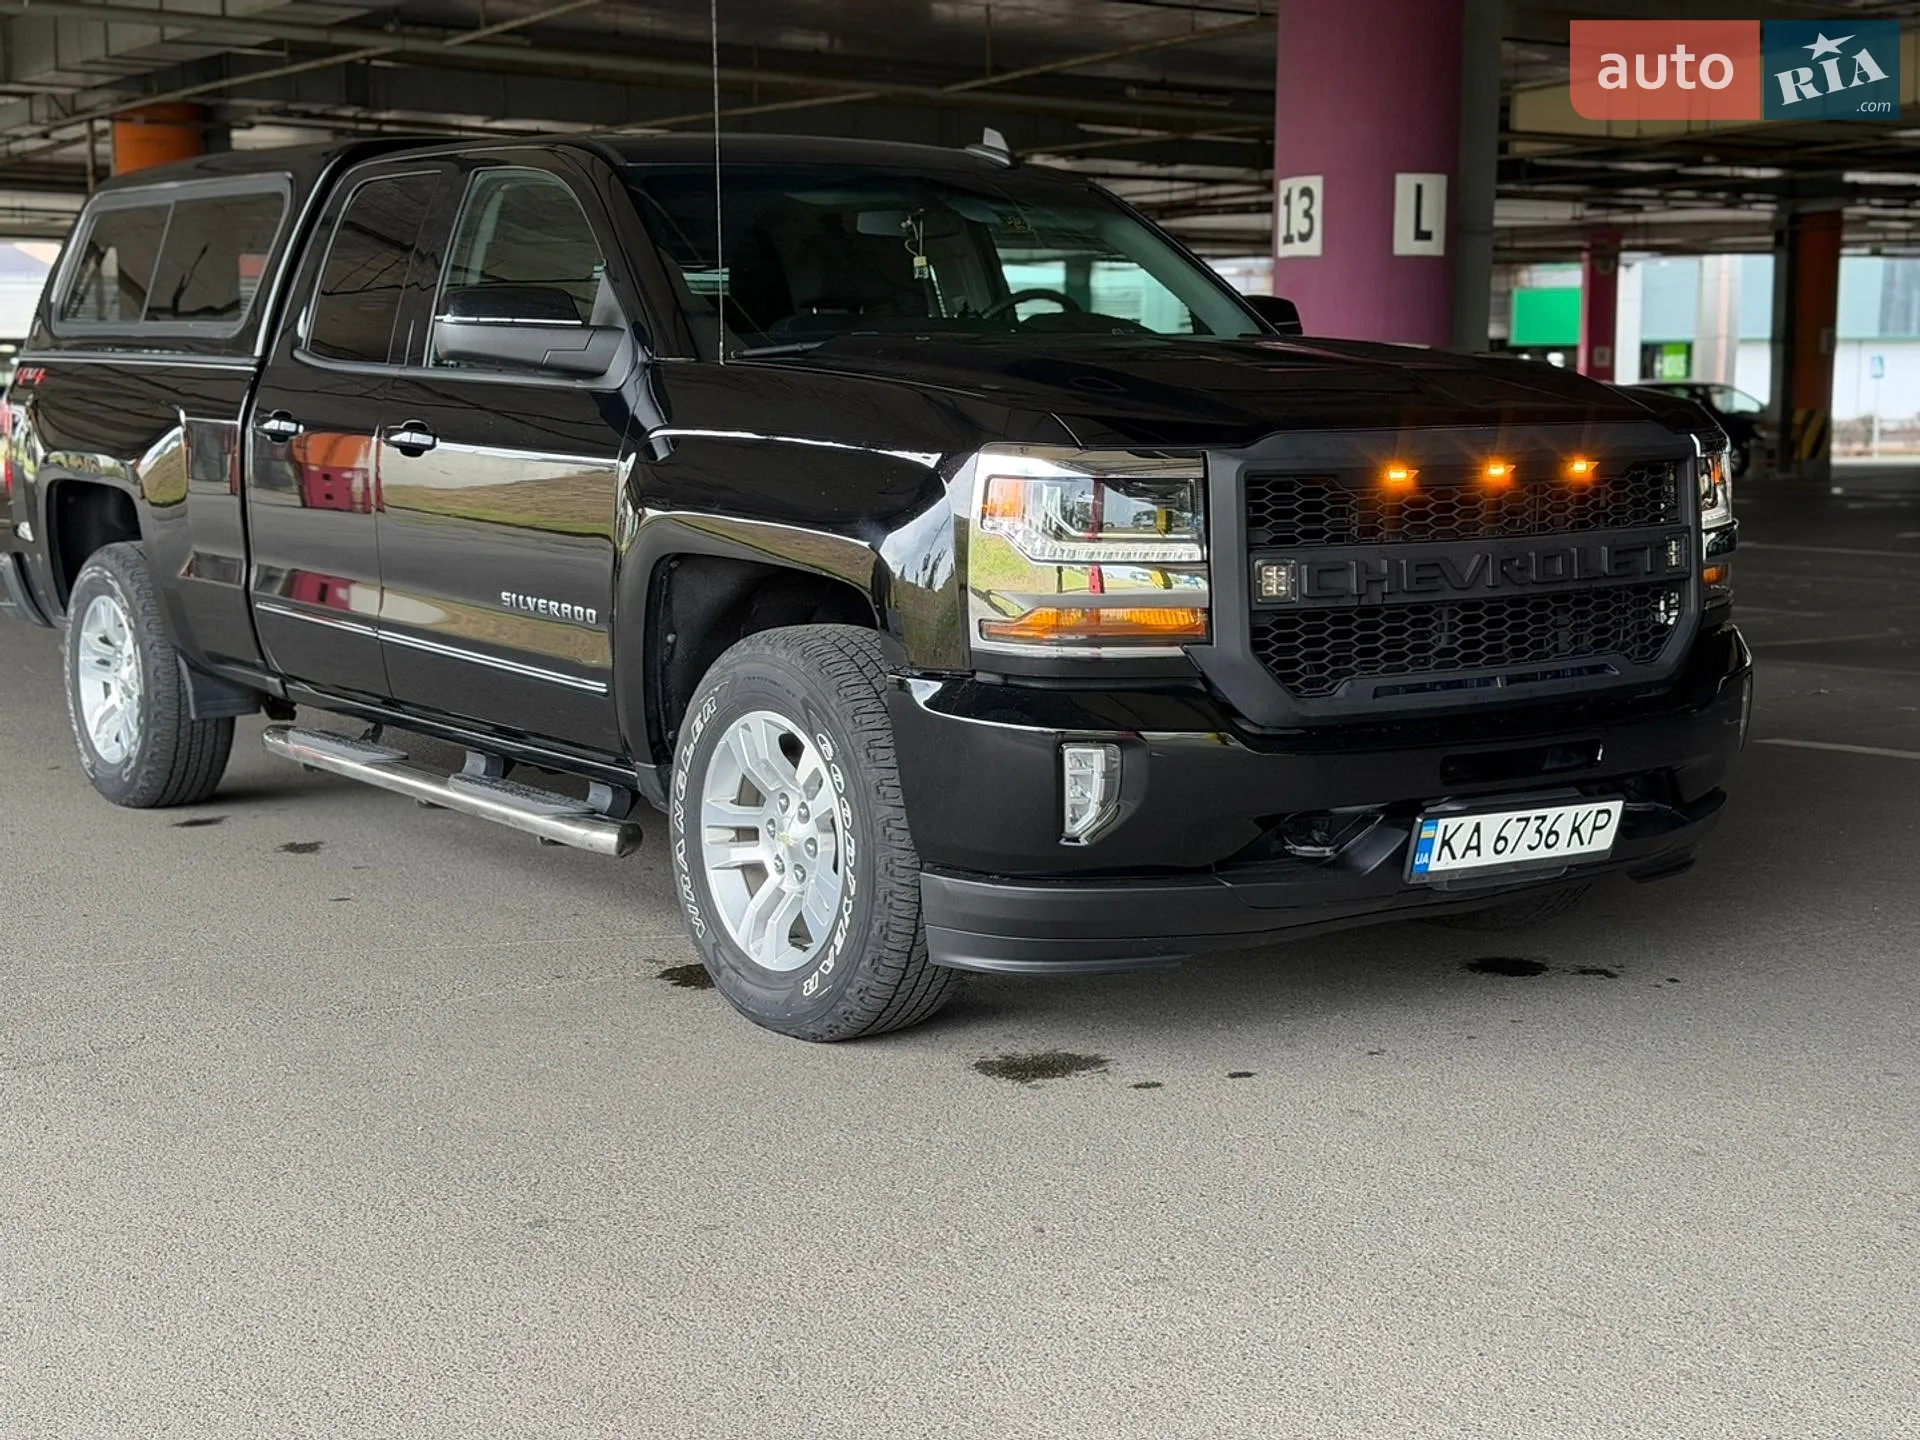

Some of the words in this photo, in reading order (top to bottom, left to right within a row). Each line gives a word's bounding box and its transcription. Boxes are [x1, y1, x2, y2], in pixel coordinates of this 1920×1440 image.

[1283, 186, 1314, 244] 13
[1413, 183, 1433, 241] L
[1303, 545, 1664, 599] CHEVROLET
[501, 591, 597, 625] SILVERADO
[674, 696, 717, 938] WRANGLER
[1437, 821, 1483, 862] KA
[1493, 813, 1564, 855] 6736
[1566, 809, 1612, 848] KP
[803, 733, 856, 996] GOODYEAR
[1415, 853, 1430, 864] UA
